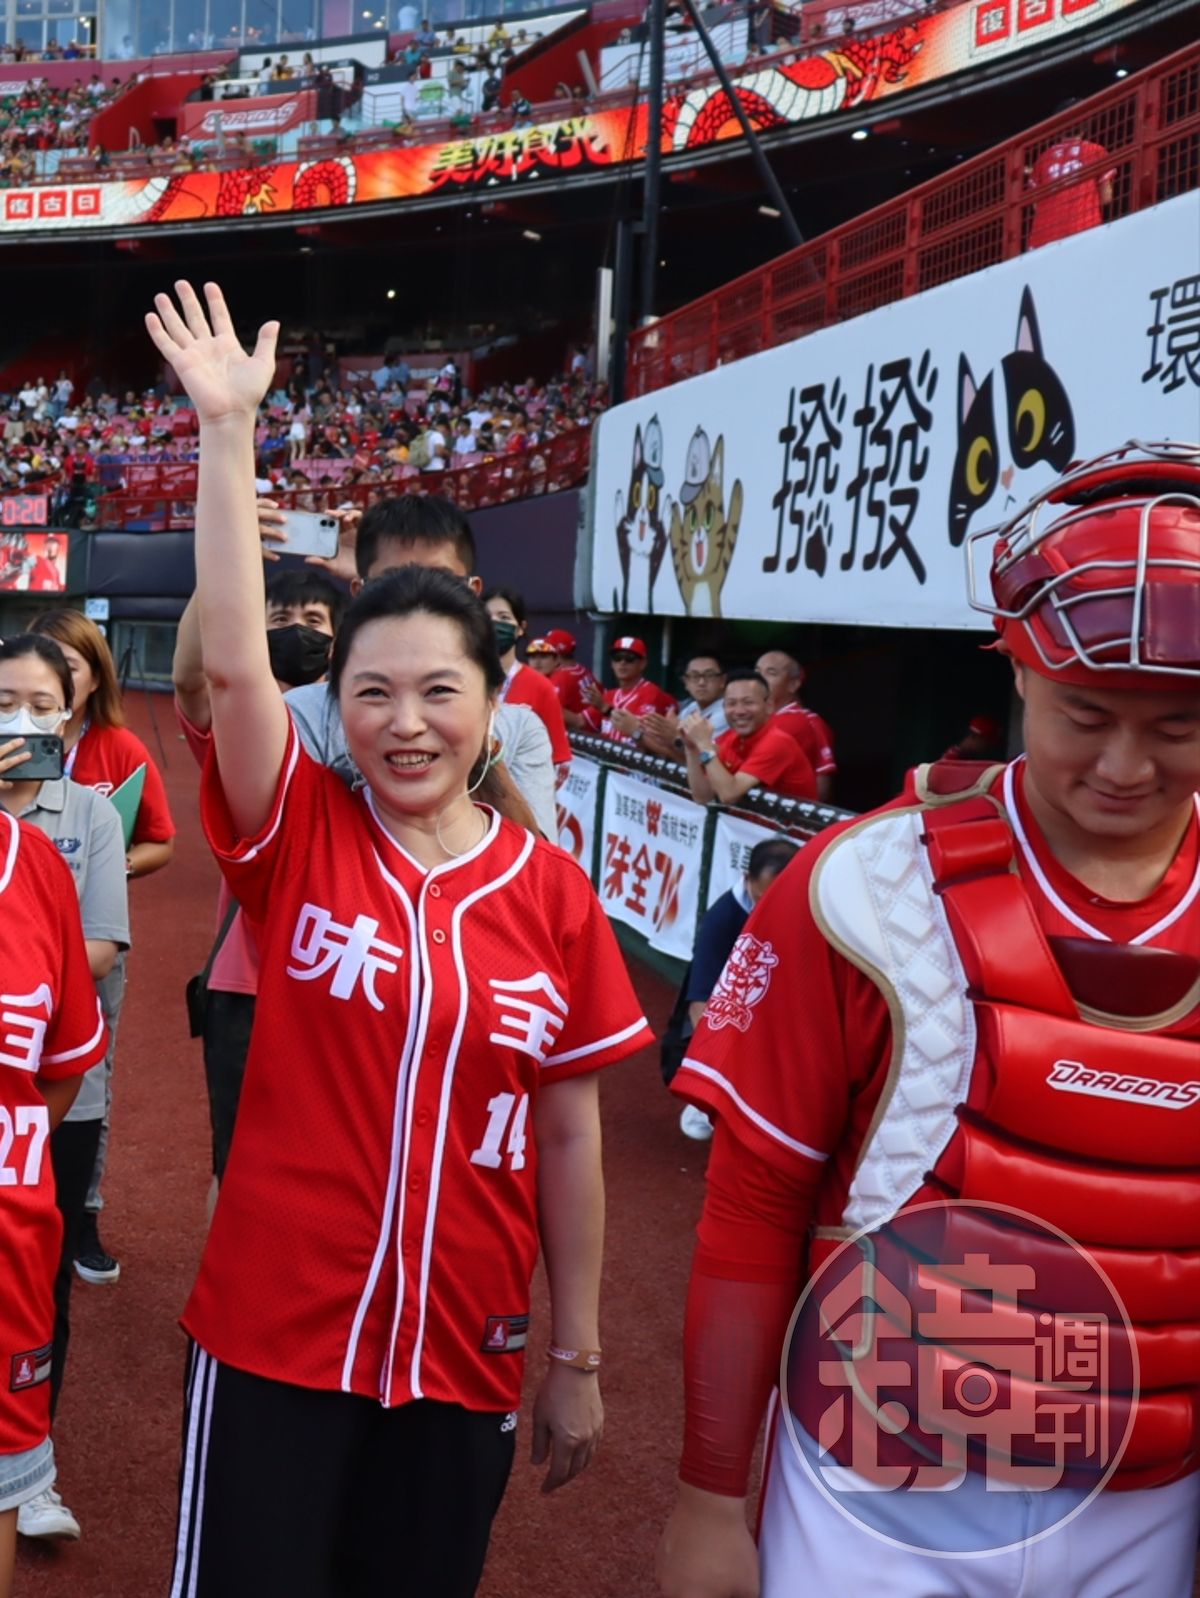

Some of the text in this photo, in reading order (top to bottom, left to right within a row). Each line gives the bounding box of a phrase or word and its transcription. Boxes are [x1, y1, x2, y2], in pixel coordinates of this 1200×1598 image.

[286, 902, 569, 1063] 味 全
[470, 1091, 530, 1171] 14
